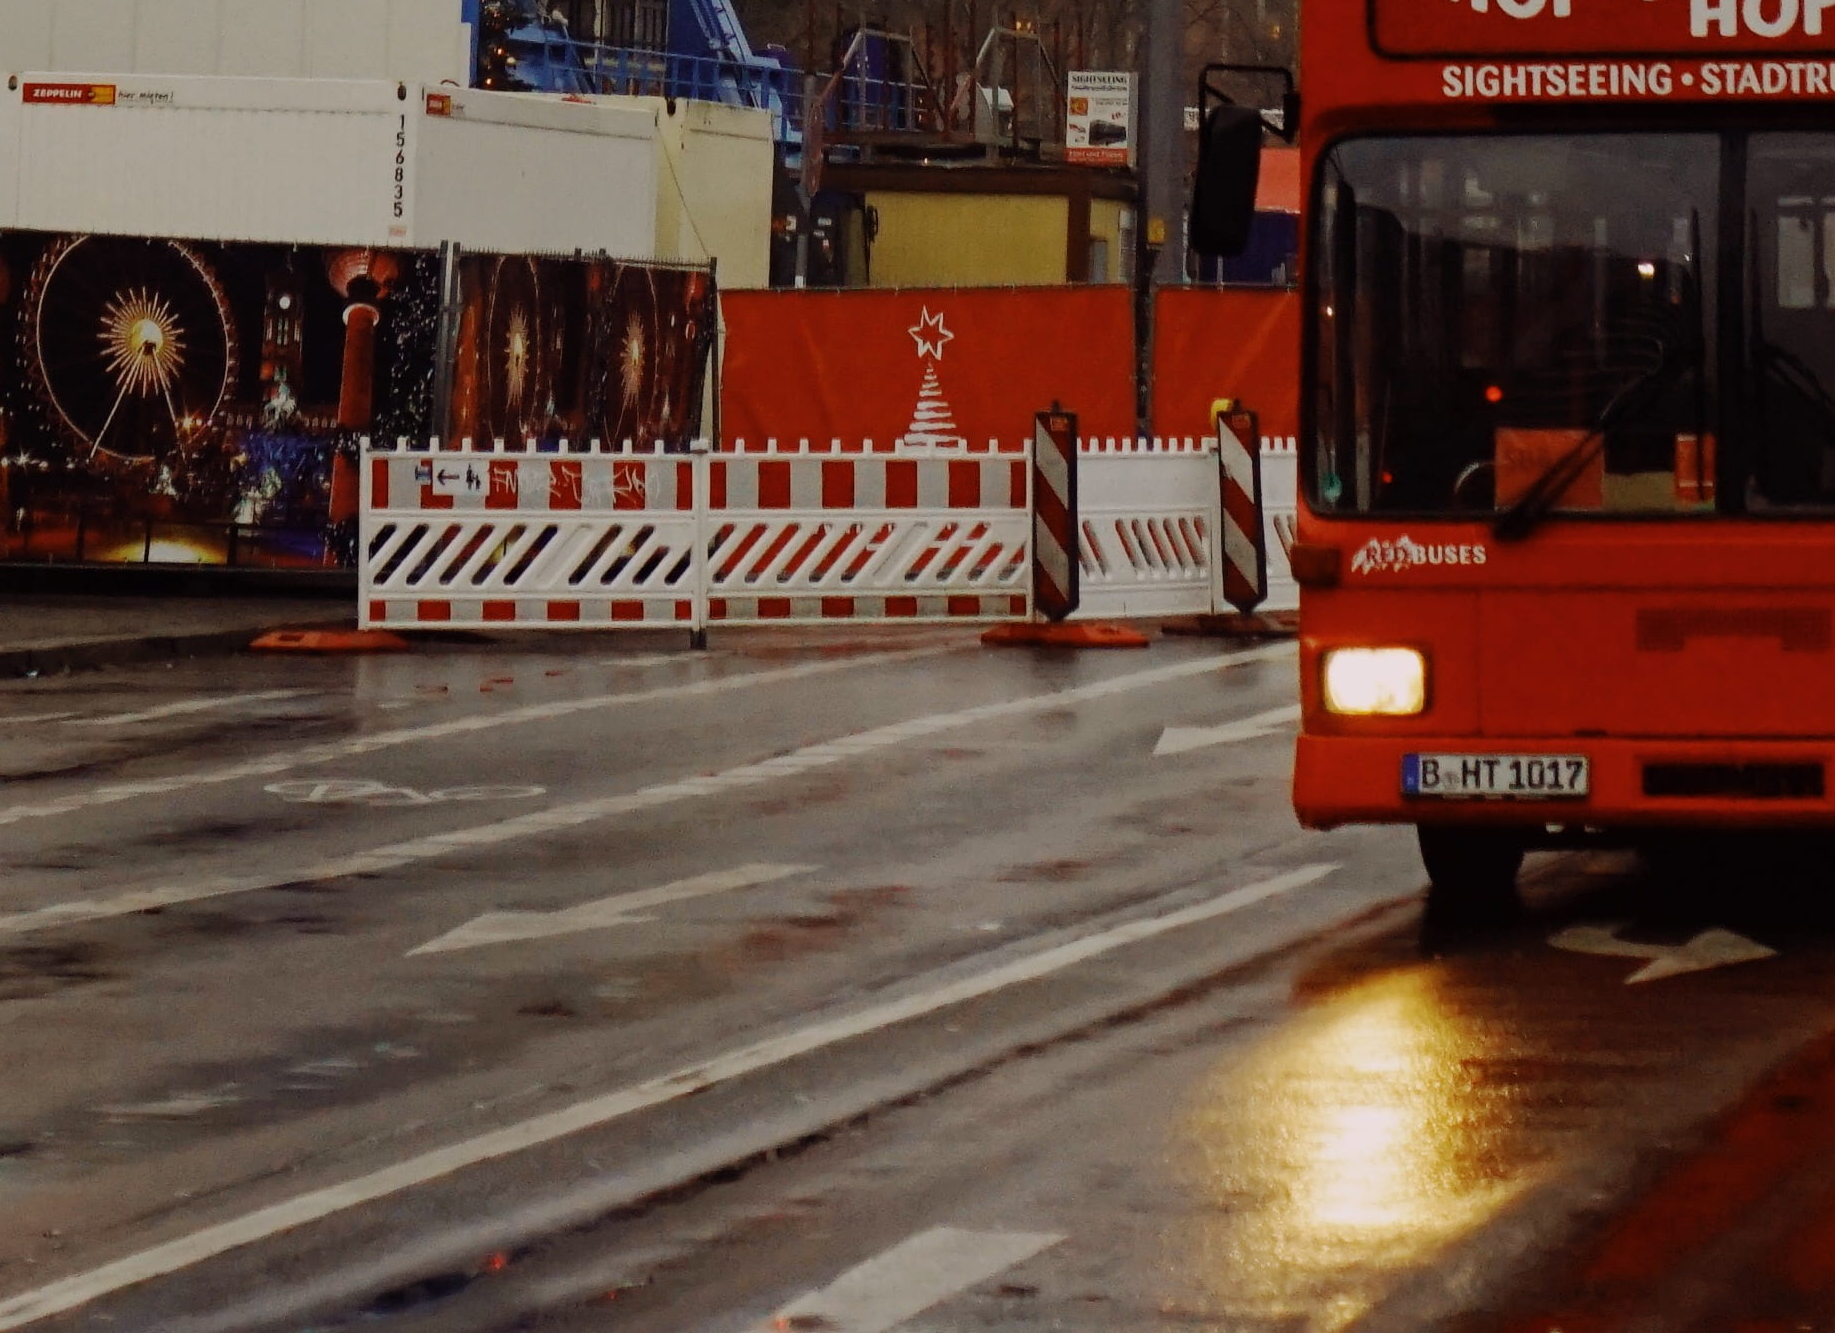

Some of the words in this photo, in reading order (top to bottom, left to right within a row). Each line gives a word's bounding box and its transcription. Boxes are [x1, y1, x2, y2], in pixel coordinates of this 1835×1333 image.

[32, 88, 83, 99] ZEPPELIN
[1441, 64, 1673, 97] SIGHTSEEING
[394, 114, 405, 218] 156835
[1422, 759, 1440, 789] B
[1462, 759, 1500, 789] HT
[1509, 759, 1583, 790] 1017
